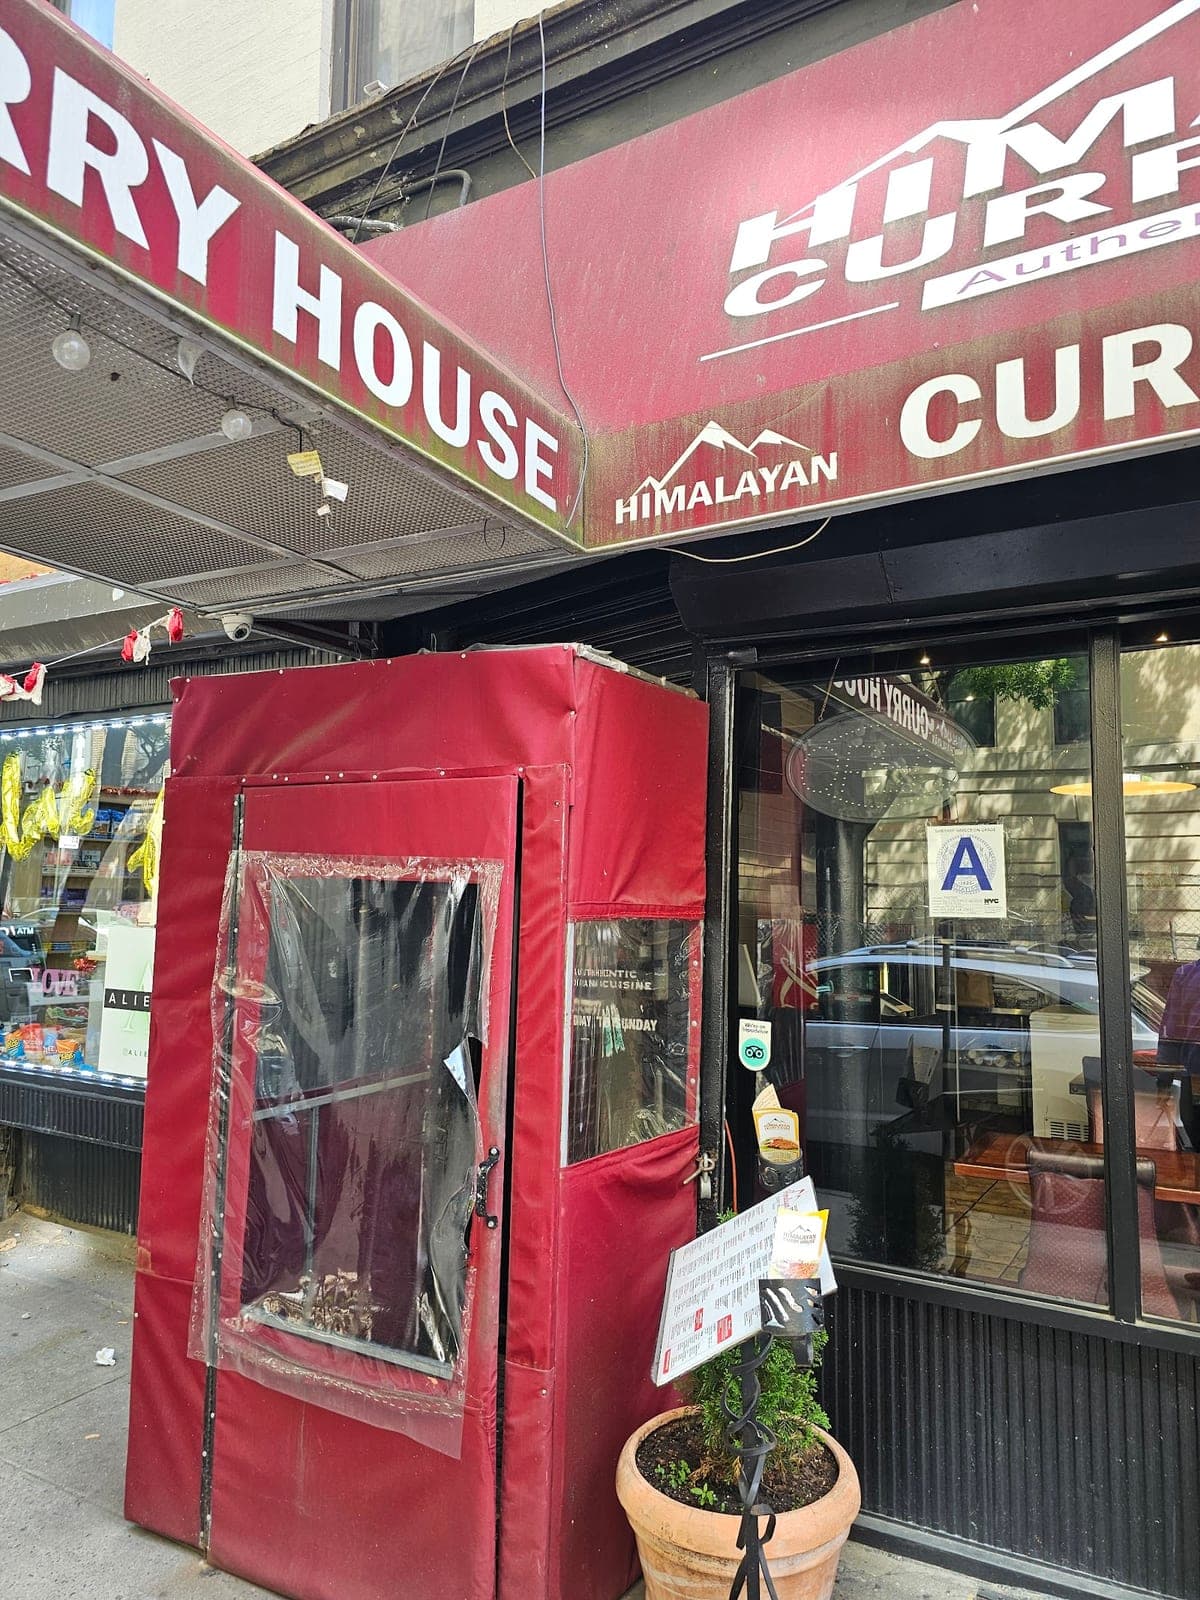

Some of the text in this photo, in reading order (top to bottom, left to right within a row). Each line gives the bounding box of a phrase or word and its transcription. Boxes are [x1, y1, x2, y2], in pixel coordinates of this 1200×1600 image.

[729, 76, 1200, 273] HIM
[957, 210, 1200, 295] Authe
[272, 230, 559, 512] HOUSE
[614, 322, 1200, 525] HIMALAYAN CUR
[941, 837, 993, 891] A
[16, 927, 34, 935] ATM
[108, 992, 151, 1008] ALIE
[613, 1017, 658, 1032] UNDAY
